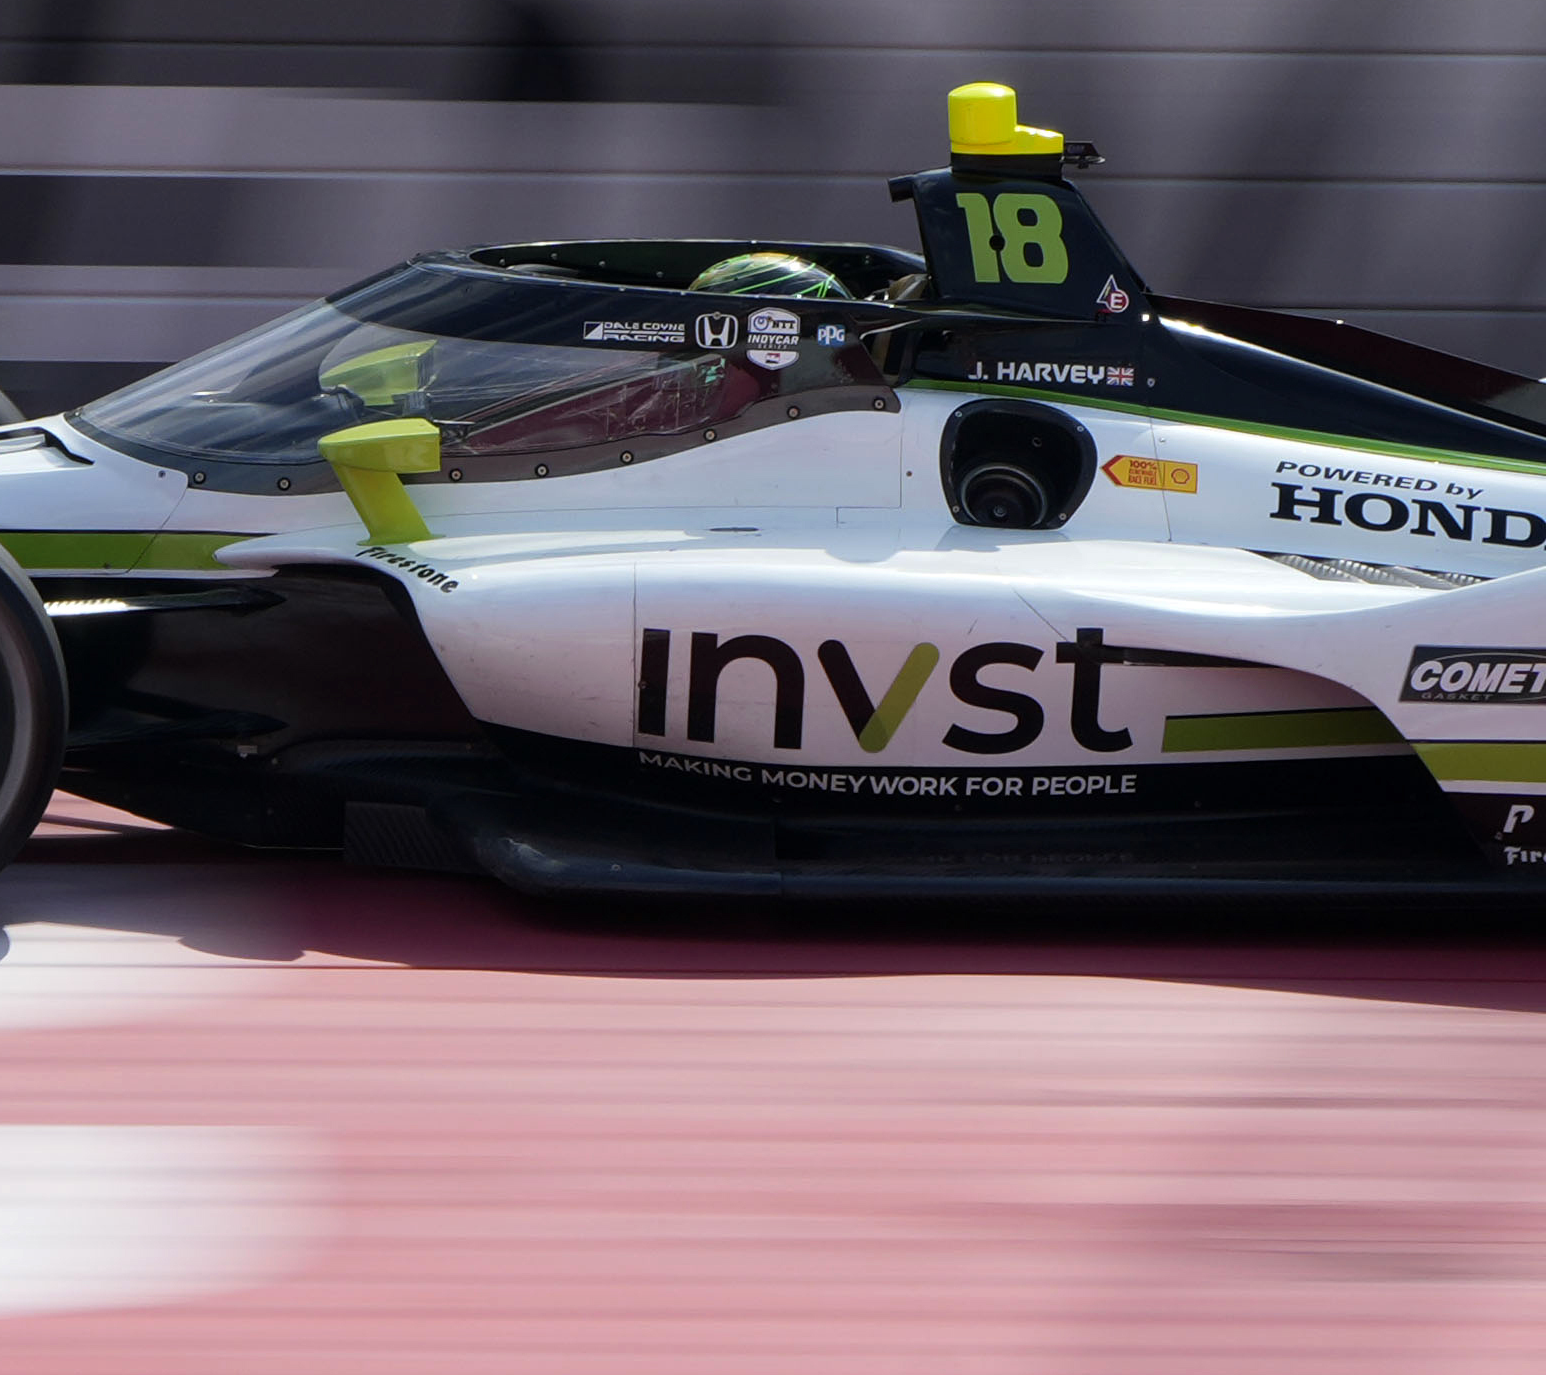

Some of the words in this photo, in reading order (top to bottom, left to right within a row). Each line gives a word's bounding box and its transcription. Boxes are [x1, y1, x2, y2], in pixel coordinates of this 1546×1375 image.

[956, 192, 1069, 285] 18
[603, 321, 637, 331] DALE
[642, 322, 685, 332] COYNE
[817, 325, 846, 345] PPG
[603, 334, 686, 343] RACING
[747, 334, 800, 346] INDYCAR
[968, 361, 989, 381] J.
[997, 361, 1105, 385] HARVEY
[1275, 460, 1438, 492] POWERED
[1445, 482, 1485, 500] by
[355, 546, 460, 594] Firestone
[1421, 692, 1496, 702] GASKET
[638, 751, 753, 782] MAKING
[761, 768, 867, 793] MONEY
[867, 773, 958, 797] WORK
[965, 775, 1024, 797] FOR
[1031, 773, 1137, 796] PEOPLE
